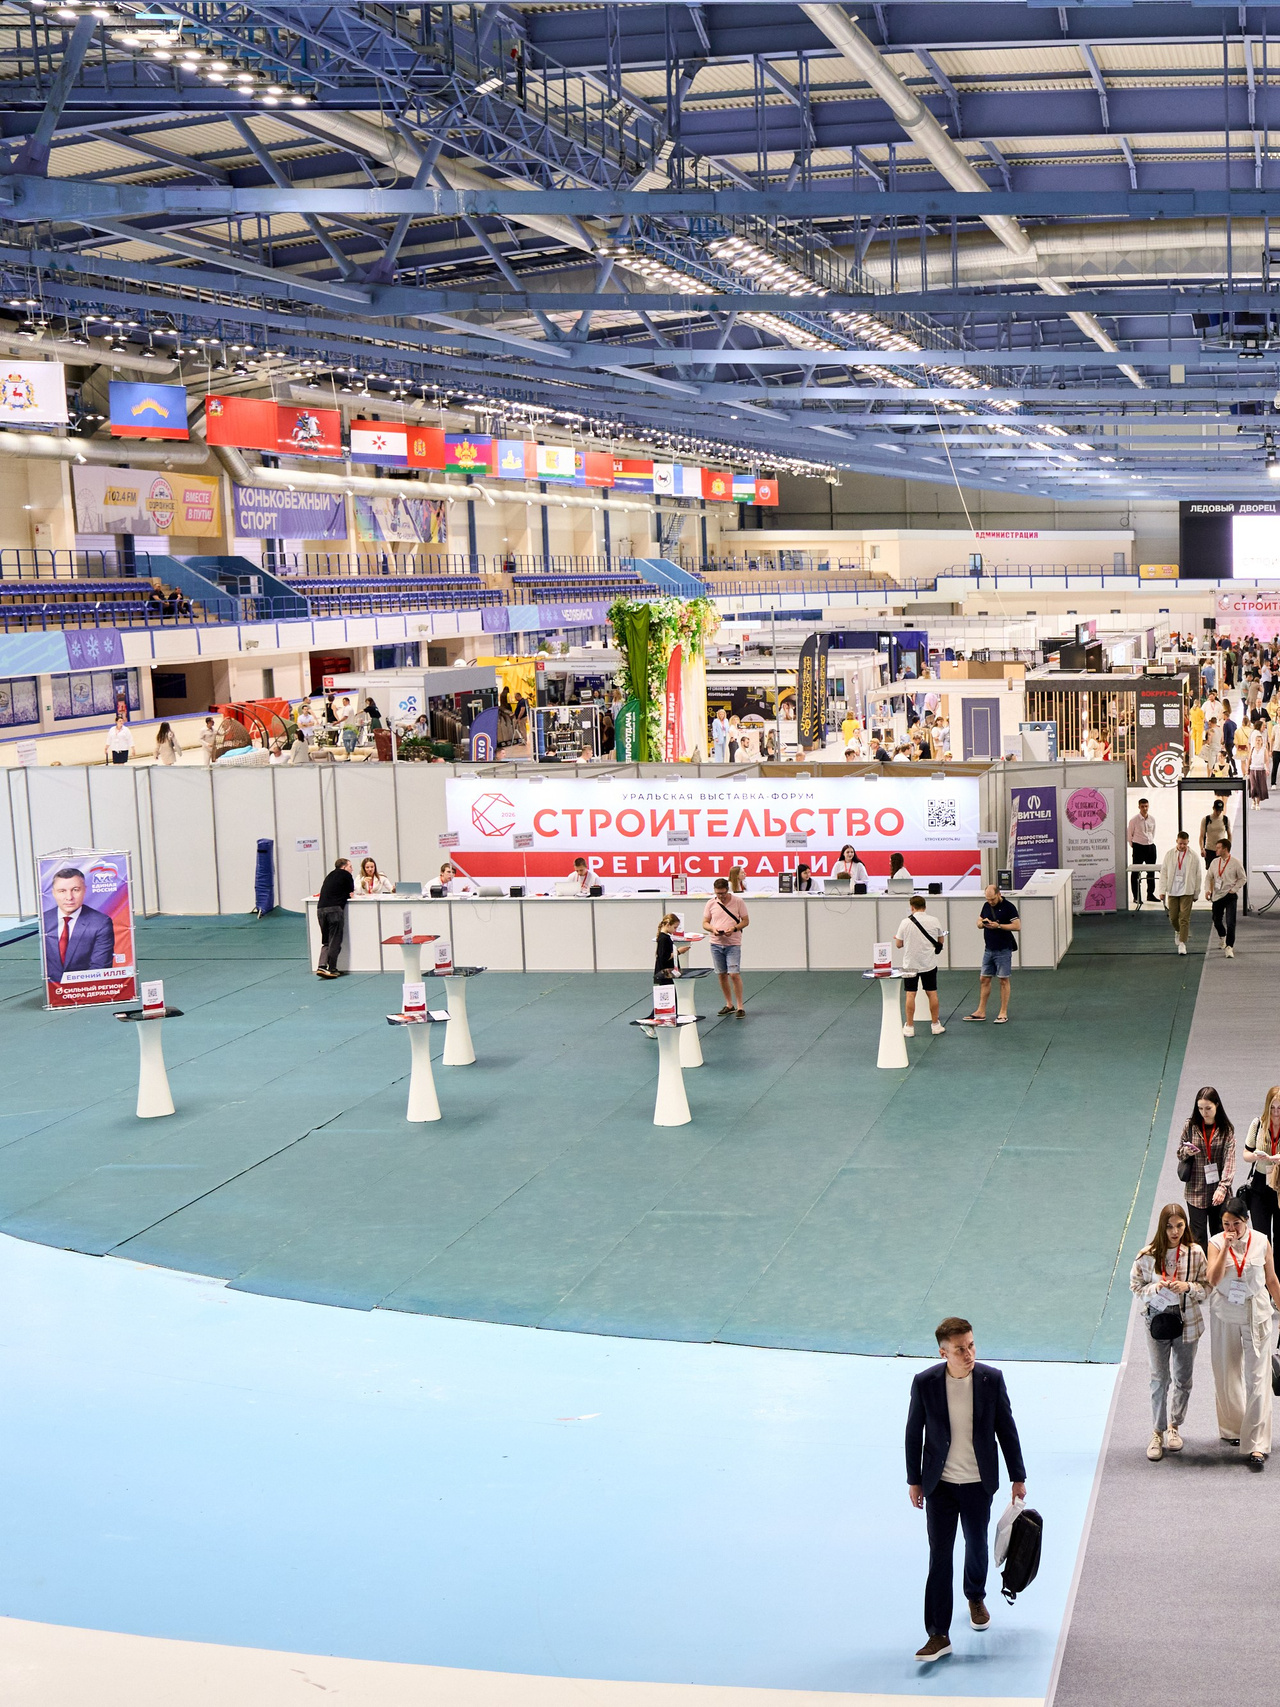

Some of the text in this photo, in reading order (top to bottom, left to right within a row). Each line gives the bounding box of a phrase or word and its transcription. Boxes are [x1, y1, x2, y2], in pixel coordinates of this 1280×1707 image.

[107, 490, 137, 502] 102.4 FM
[185, 492, 210, 504] ВМЕСТЕ
[1190, 503, 1276, 513] ЛЕДОВЫЙ ДВОРЕЦ
[188, 508, 213, 521] В ПУТИ!
[240, 511, 277, 531] СПОРТ
[975, 531, 1039, 540] АДМИНИСТРАЦИЯ
[561, 607, 594, 621] ЧЕЛЯБИНСК
[1142, 742, 1169, 776] ВОКРУГ
[1017, 810, 1052, 819] ВИТЧЕЛ
[533, 808, 905, 838] СТРОИТЕЛЬСТВО
[588, 856, 840, 874] РЕГИСТРАЦИ
[66, 969, 127, 981] Евгений ИЛЛЕ
[62, 988, 120, 1000] ОПОРА ДЕРЖАВЫ
[63, 985, 97, 994] СИЛЬНЫЙ
[97, 983, 123, 991] РЕГИОН
